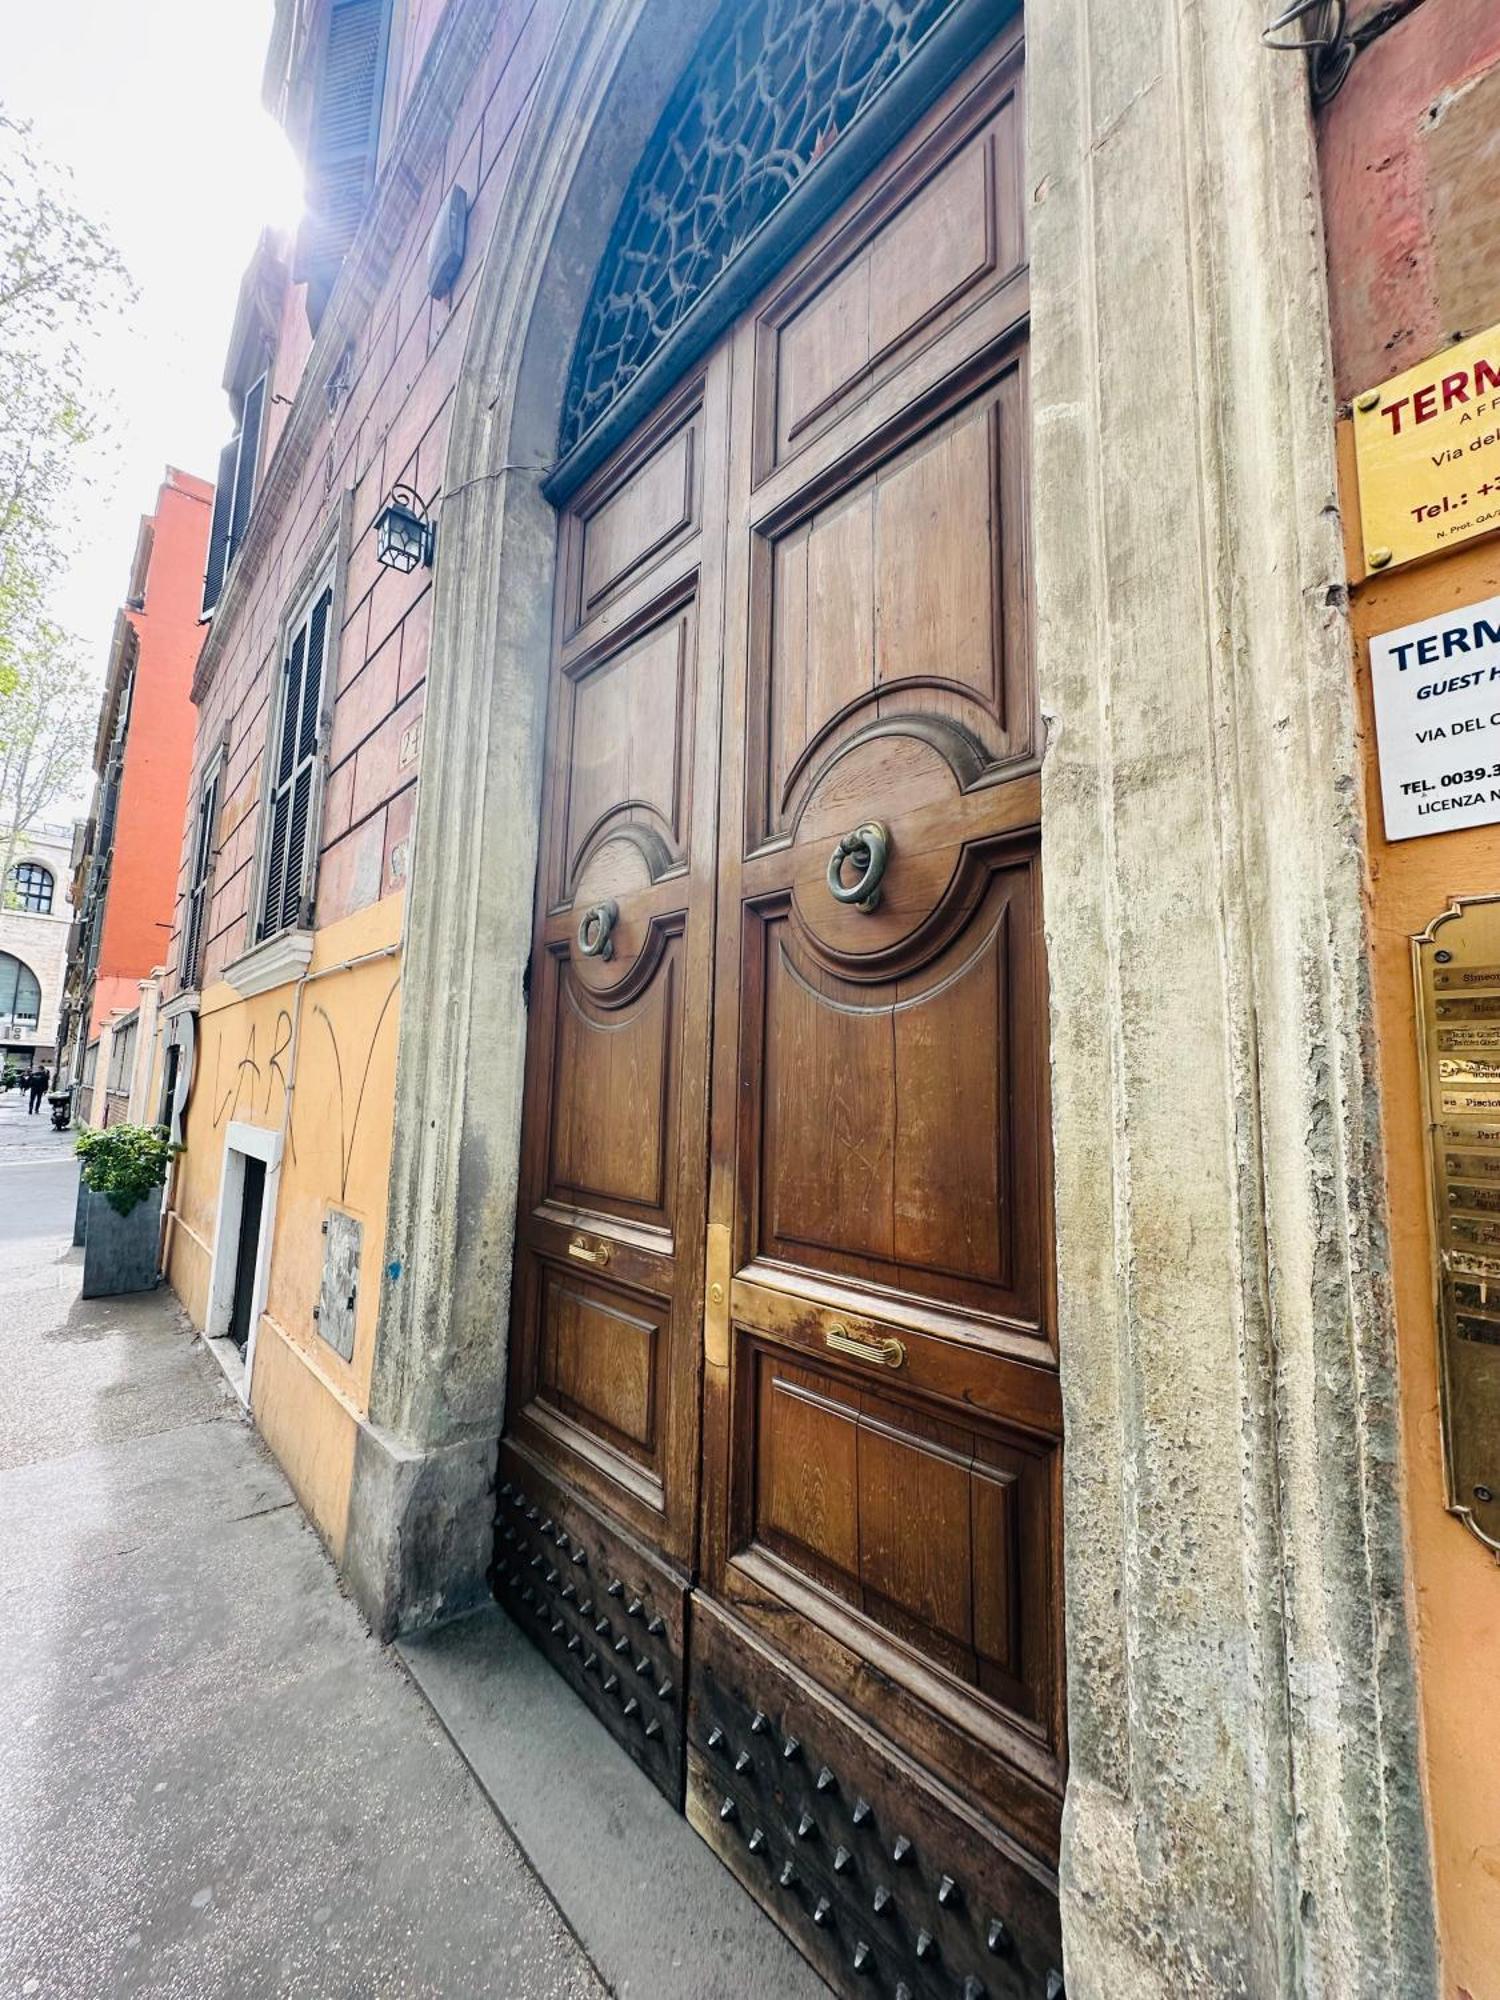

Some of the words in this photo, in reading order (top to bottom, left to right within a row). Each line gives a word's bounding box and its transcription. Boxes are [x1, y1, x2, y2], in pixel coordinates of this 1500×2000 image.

[1432, 448, 1463, 466] Via
[1411, 493, 1468, 523] Tel.:
[1437, 531, 1448, 539] N.
[1450, 521, 1473, 533] Prot.
[1417, 670, 1485, 700] GUEST
[1416, 727, 1446, 743] VIA
[1452, 718, 1485, 735] DEL
[1400, 780, 1436, 795] TEL.
[1441, 763, 1500, 787] 0039.3
[1418, 793, 1485, 815] LICENZA
